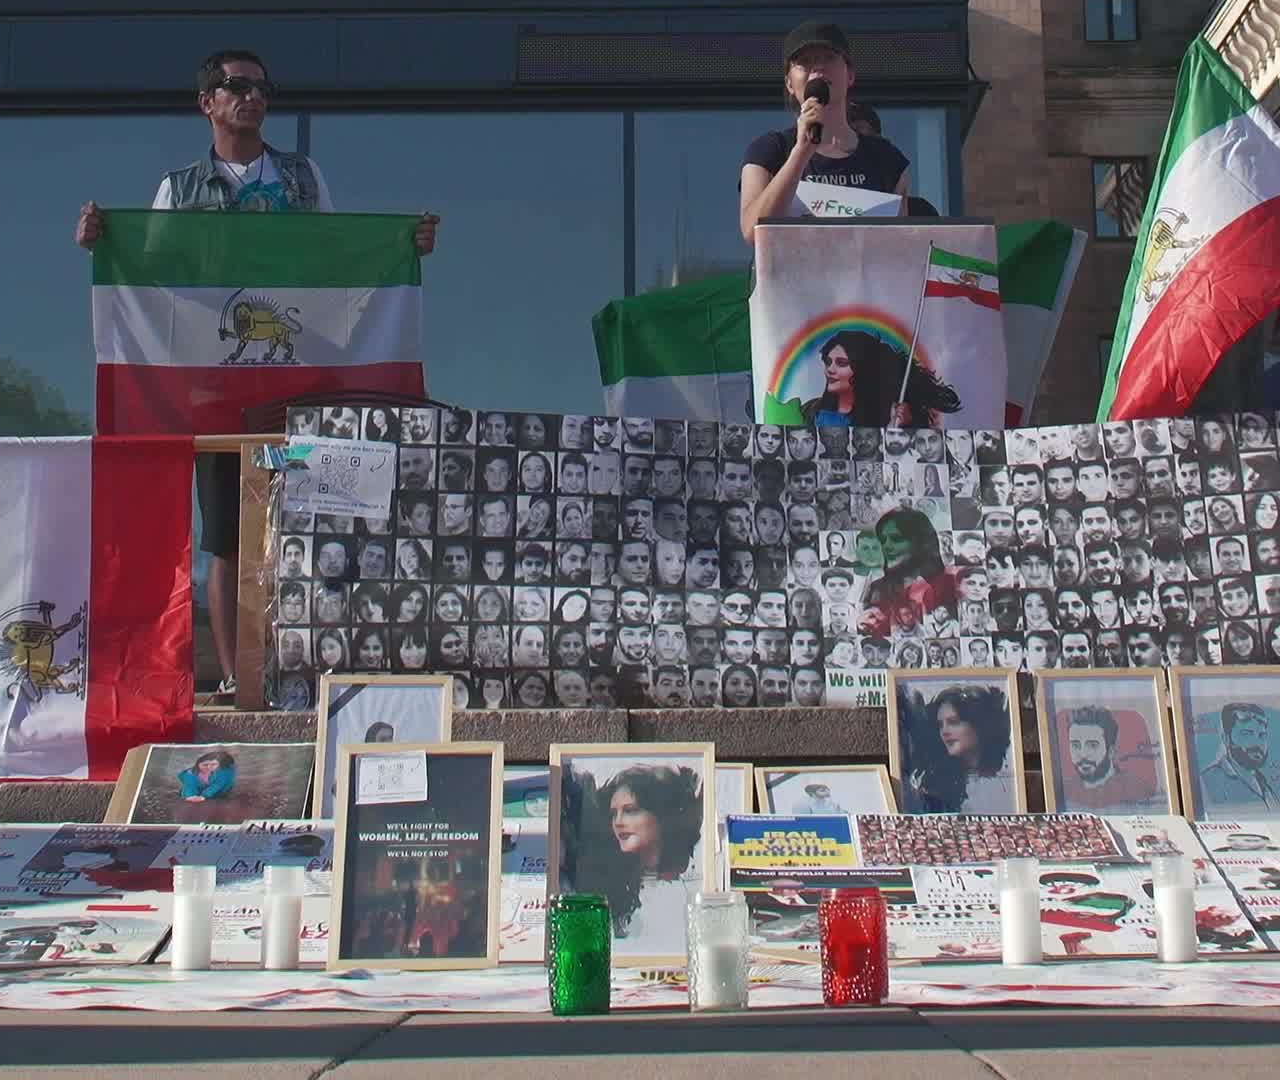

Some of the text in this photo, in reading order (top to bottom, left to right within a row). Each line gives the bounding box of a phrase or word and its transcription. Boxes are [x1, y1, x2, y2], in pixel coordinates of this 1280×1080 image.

[850, 174, 866, 185] UP
[811, 199, 865, 216] #Free
[829, 673, 854, 687] We
[359, 832, 479, 842] WOMEN, LIFE, FREEDOM
